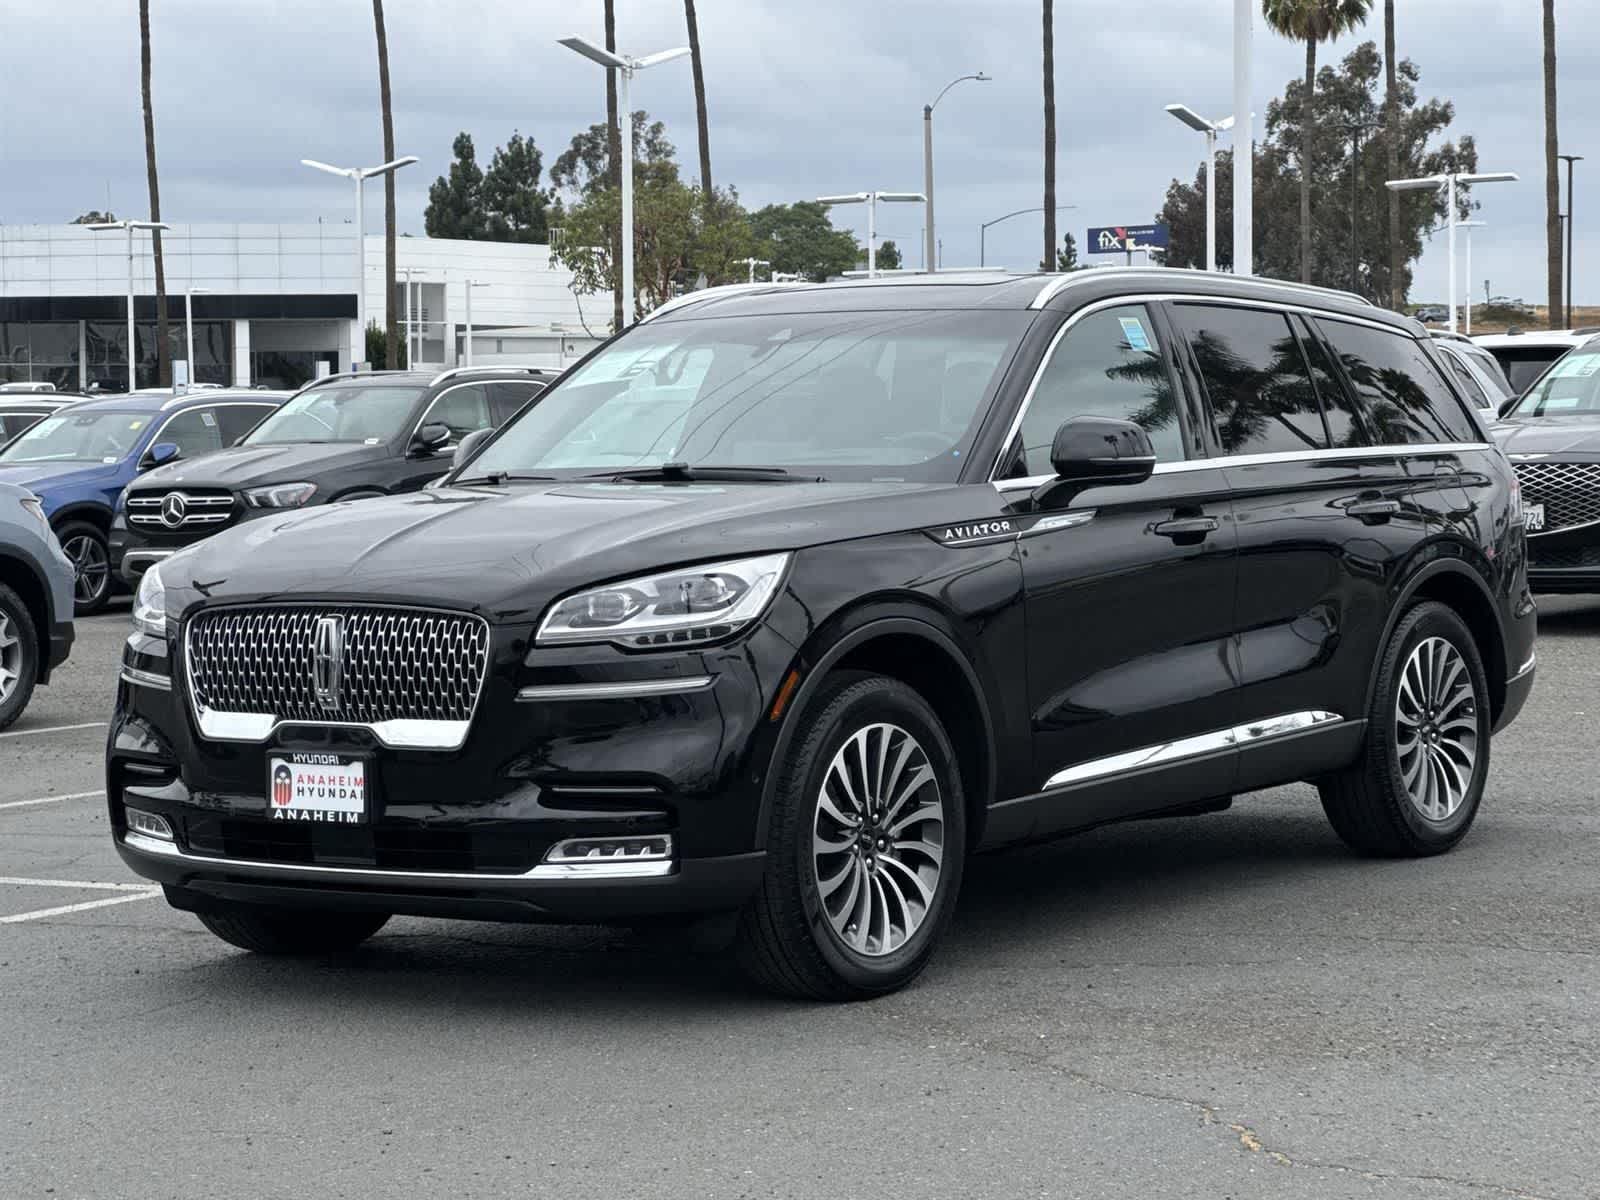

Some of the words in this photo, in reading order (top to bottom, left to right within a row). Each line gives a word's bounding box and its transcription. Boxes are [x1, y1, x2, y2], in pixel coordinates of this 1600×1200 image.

[944, 520, 1011, 539] AVIATOR
[292, 753, 340, 765] HYUNDAI
[297, 774, 364, 787] ANAHEIM
[297, 786, 363, 800] HYUNDAI
[273, 808, 359, 824] ANAHEIM
